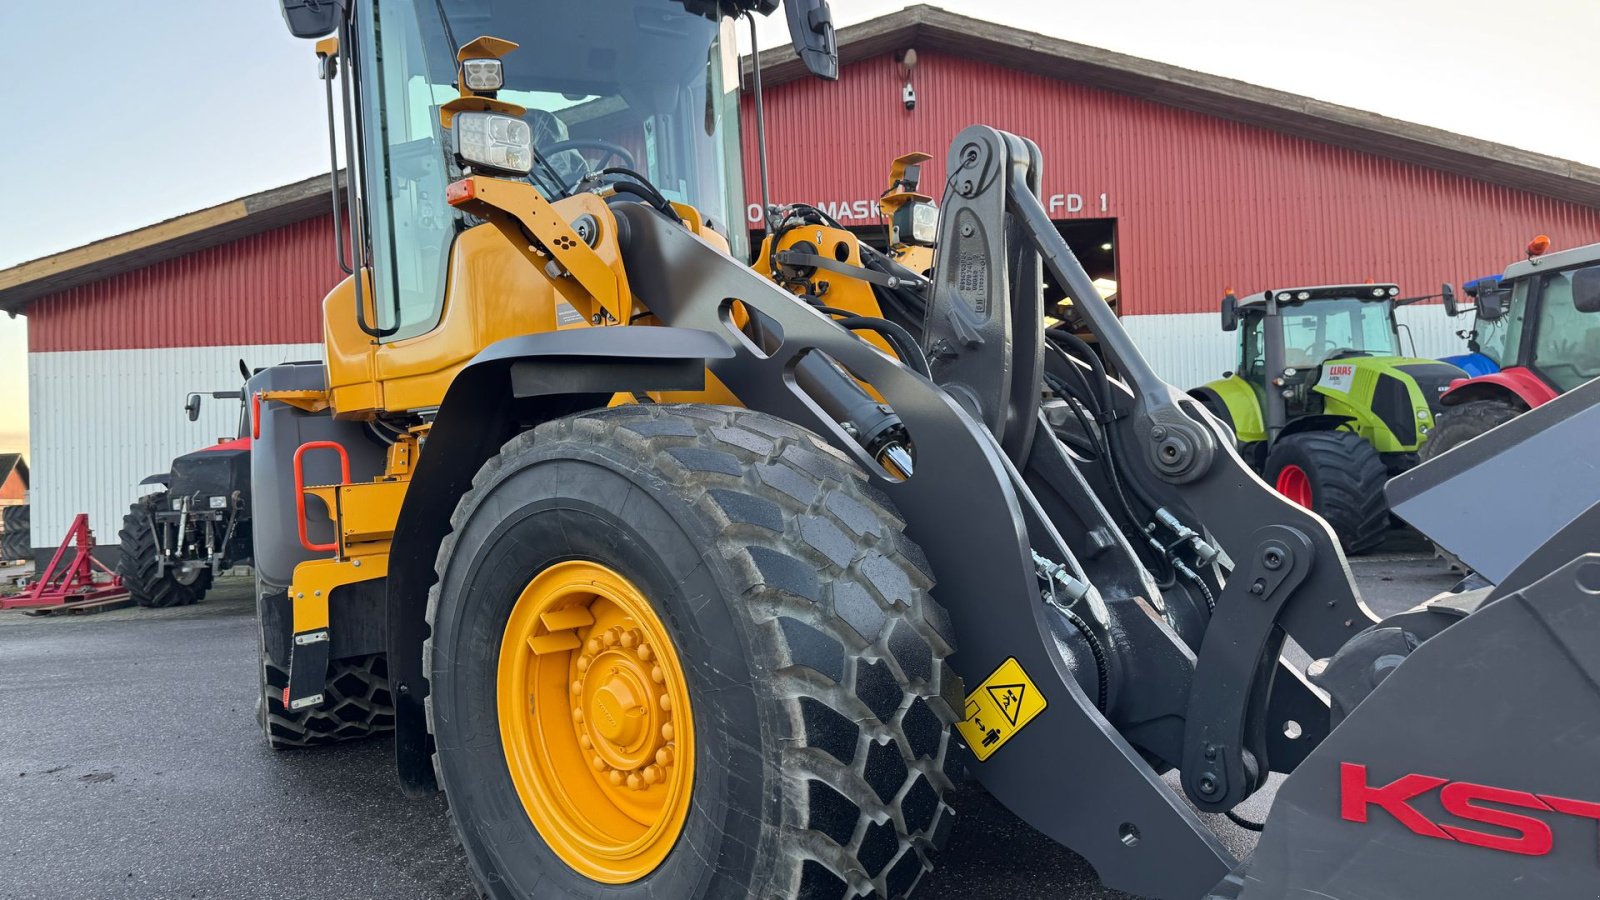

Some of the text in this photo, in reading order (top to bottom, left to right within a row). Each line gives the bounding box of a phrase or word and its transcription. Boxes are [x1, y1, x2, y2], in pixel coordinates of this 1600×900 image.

[817, 199, 885, 220] MASK
[1100, 192, 1107, 212] 1
[1330, 366, 1352, 376] CLAAS
